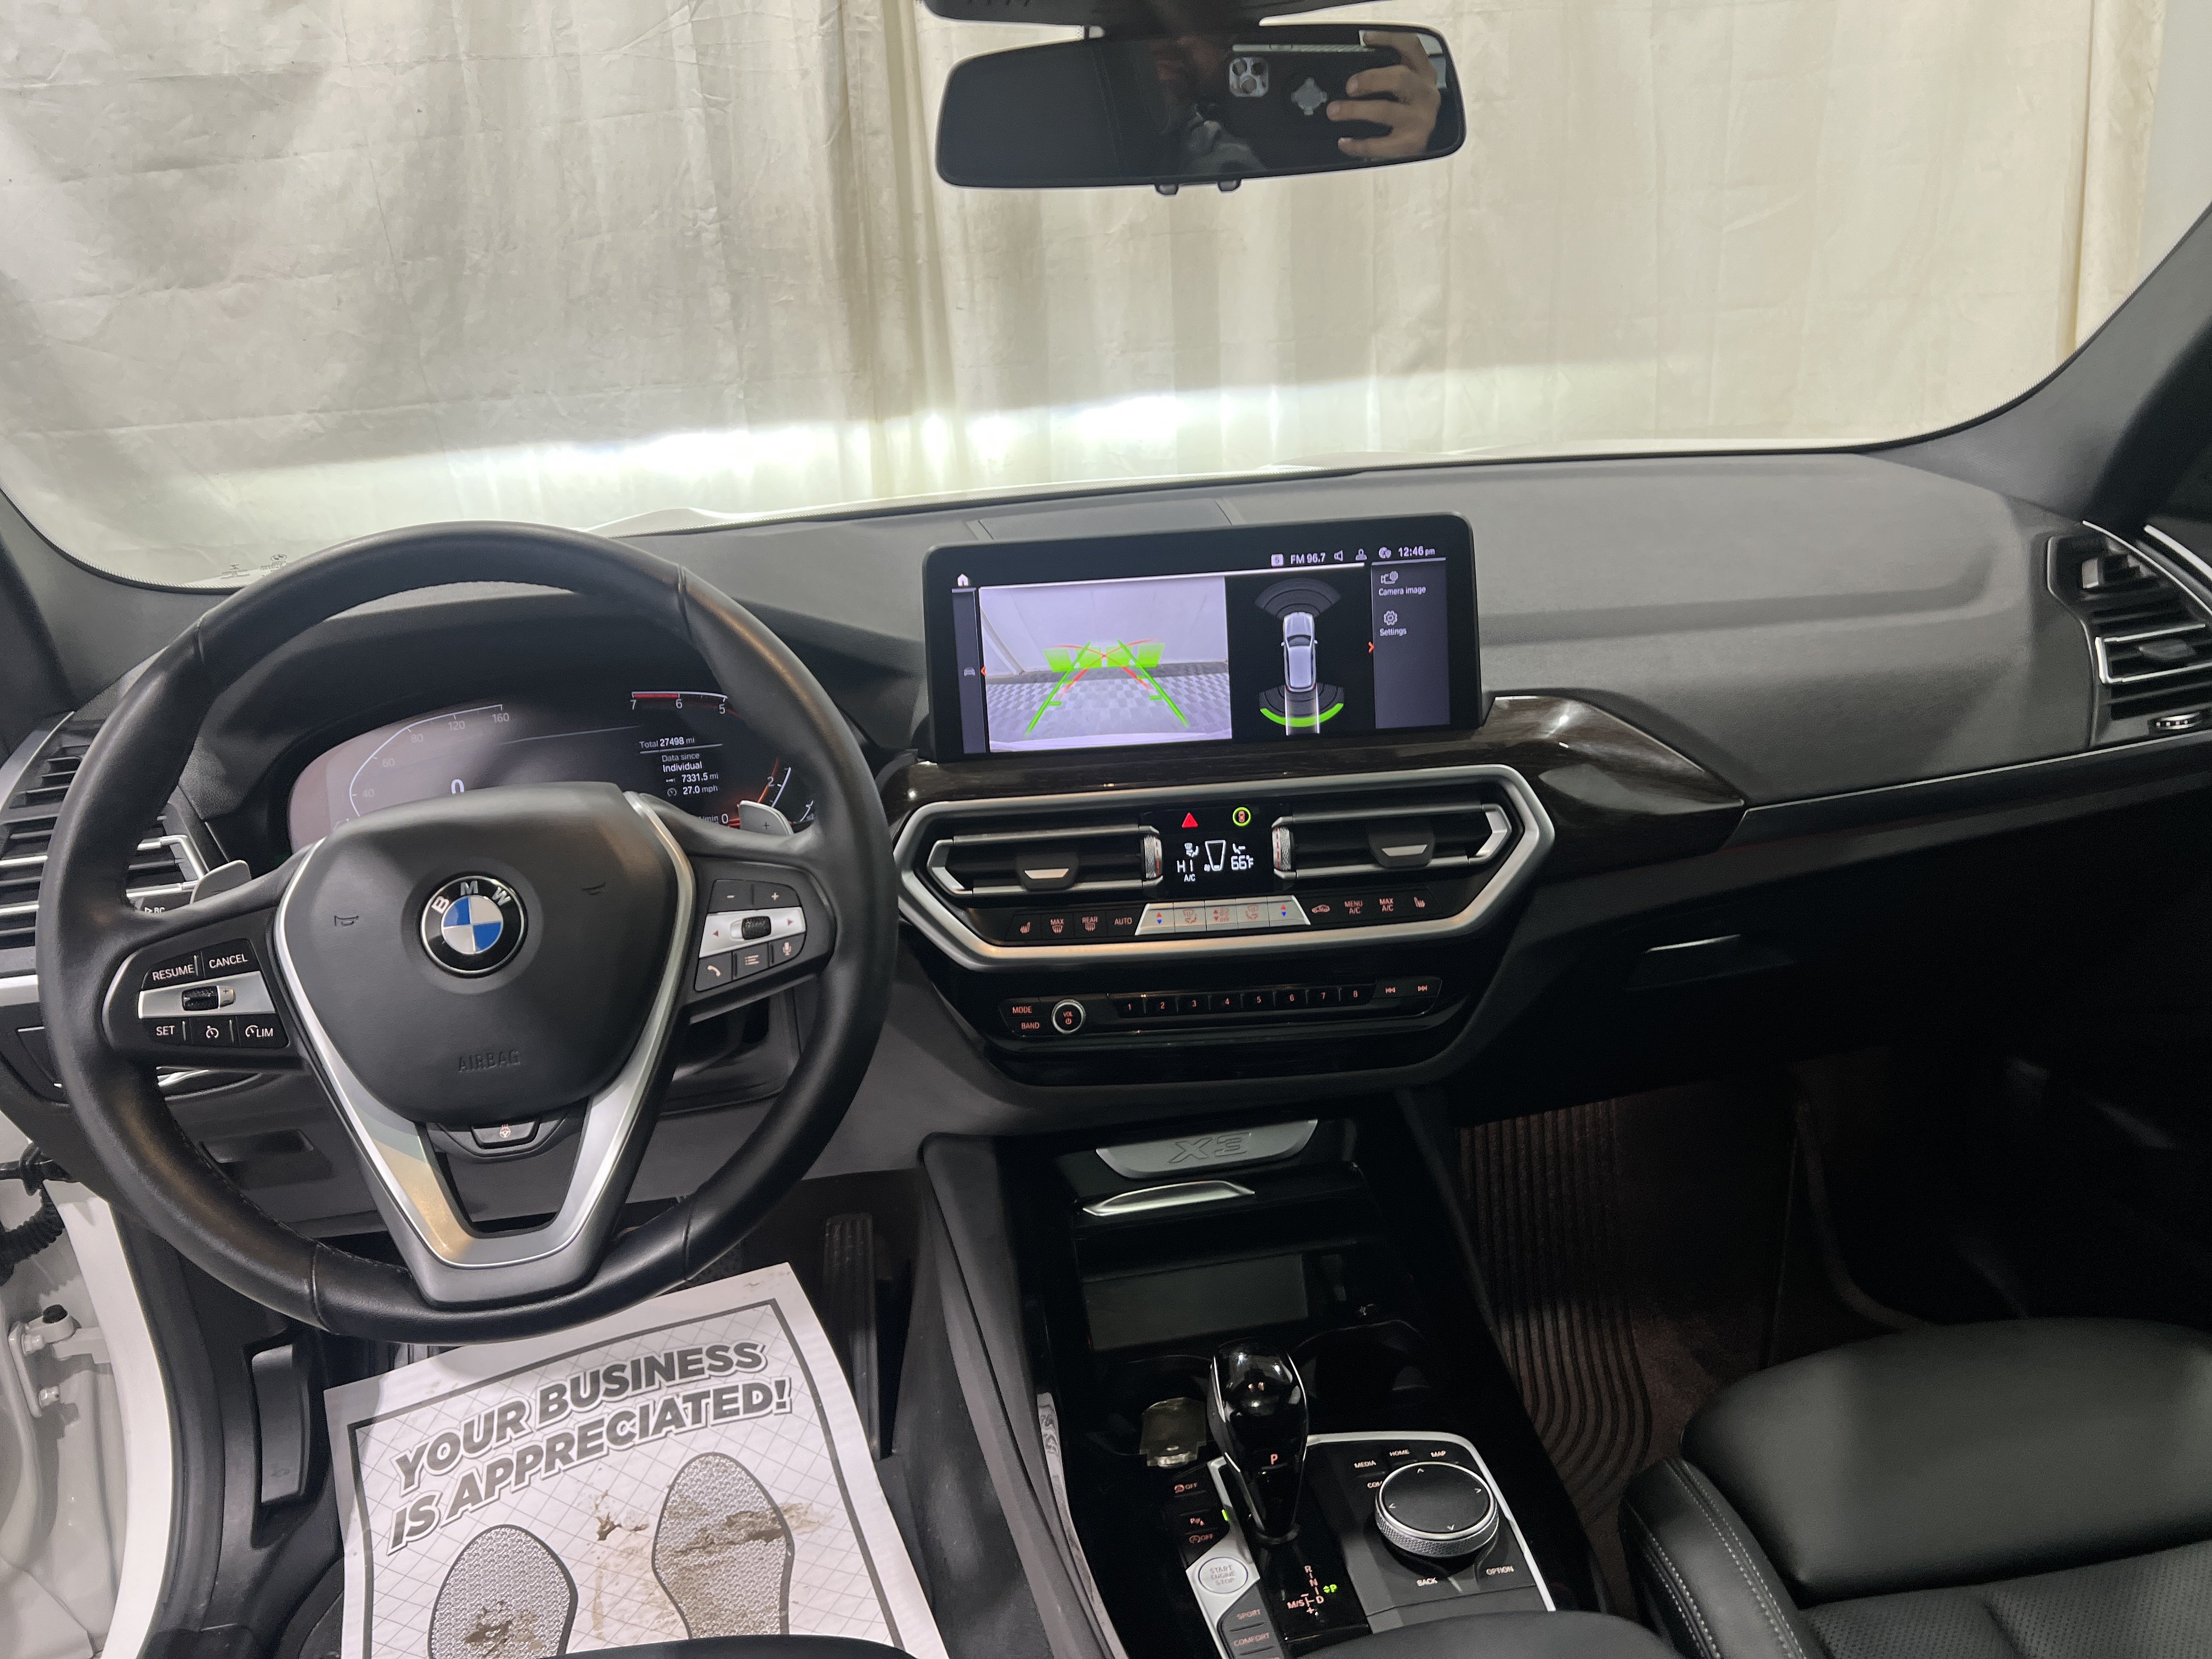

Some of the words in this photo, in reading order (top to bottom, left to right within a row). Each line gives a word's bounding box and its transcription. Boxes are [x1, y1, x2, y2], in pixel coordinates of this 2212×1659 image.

[1398, 546, 1424, 557] 12:46
[1425, 548, 1435, 557] pm
[1290, 554, 1305, 565] FM
[1307, 552, 1326, 563] 96.7
[1379, 588, 1404, 596] Camera
[1406, 586, 1426, 595] image
[1379, 628, 1407, 636] Settings
[630, 699, 636, 710] 7
[675, 698, 682, 709] 6
[719, 704, 726, 714] 5
[492, 713, 509, 723] 160
[448, 720, 465, 731] 120
[411, 733, 424, 743] 80
[639, 741, 658, 749] Total
[659, 737, 685, 747] 27498
[662, 754, 679, 762] Data
[680, 752, 700, 761] since
[382, 758, 395, 768] 60
[663, 761, 703, 772] Individual
[681, 772, 708, 783] 7331.5
[767, 776, 775, 787] 2
[362, 789, 374, 798] 40
[682, 785, 700, 795] 27.0
[702, 785, 718, 795] mph
[721, 813, 729, 824] 0
[1184, 873, 1196, 882] A/C
[431, 881, 511, 914] BMW
[1114, 917, 1132, 926] AUTO
[209, 953, 249, 969] CANCEL
[152, 964, 194, 981] RESUME
[1160, 1001, 1165, 1009] 2
[1192, 1000, 1197, 1008] 3
[1012, 1006, 1032, 1014] MODE
[156, 1025, 175, 1036] SET
[1021, 1022, 1040, 1030] BAND
[256, 1027, 273, 1037] LIM
[458, 1049, 521, 1074] AIRBAG
[1169, 1132, 1251, 1164] X3
[394, 1400, 529, 1493] YOUR
[538, 1342, 766, 1422] BUSINESS
[1389, 1448, 1410, 1457] HOME
[391, 1492, 438, 1549] IS
[445, 1379, 788, 1521] APPRECIATED!
[1271, 1453, 1278, 1465] P
[1354, 1460, 1376, 1469] MEDIA
[1210, 1565, 1233, 1573] START
[1304, 1565, 1312, 1573] R
[1486, 1565, 1515, 1576] OPTION
[1211, 1571, 1235, 1580] ENGINE
[1215, 1577, 1234, 1585] STOP
[1309, 1578, 1318, 1587] N
[1417, 1577, 1438, 1587] BACK
[1329, 1584, 1337, 1593] P
[1287, 1599, 1305, 1609] M/S
[1316, 1595, 1324, 1604] D
[1237, 1608, 1261, 1620] SPORT
[1234, 1632, 1270, 1646] COMFORT
